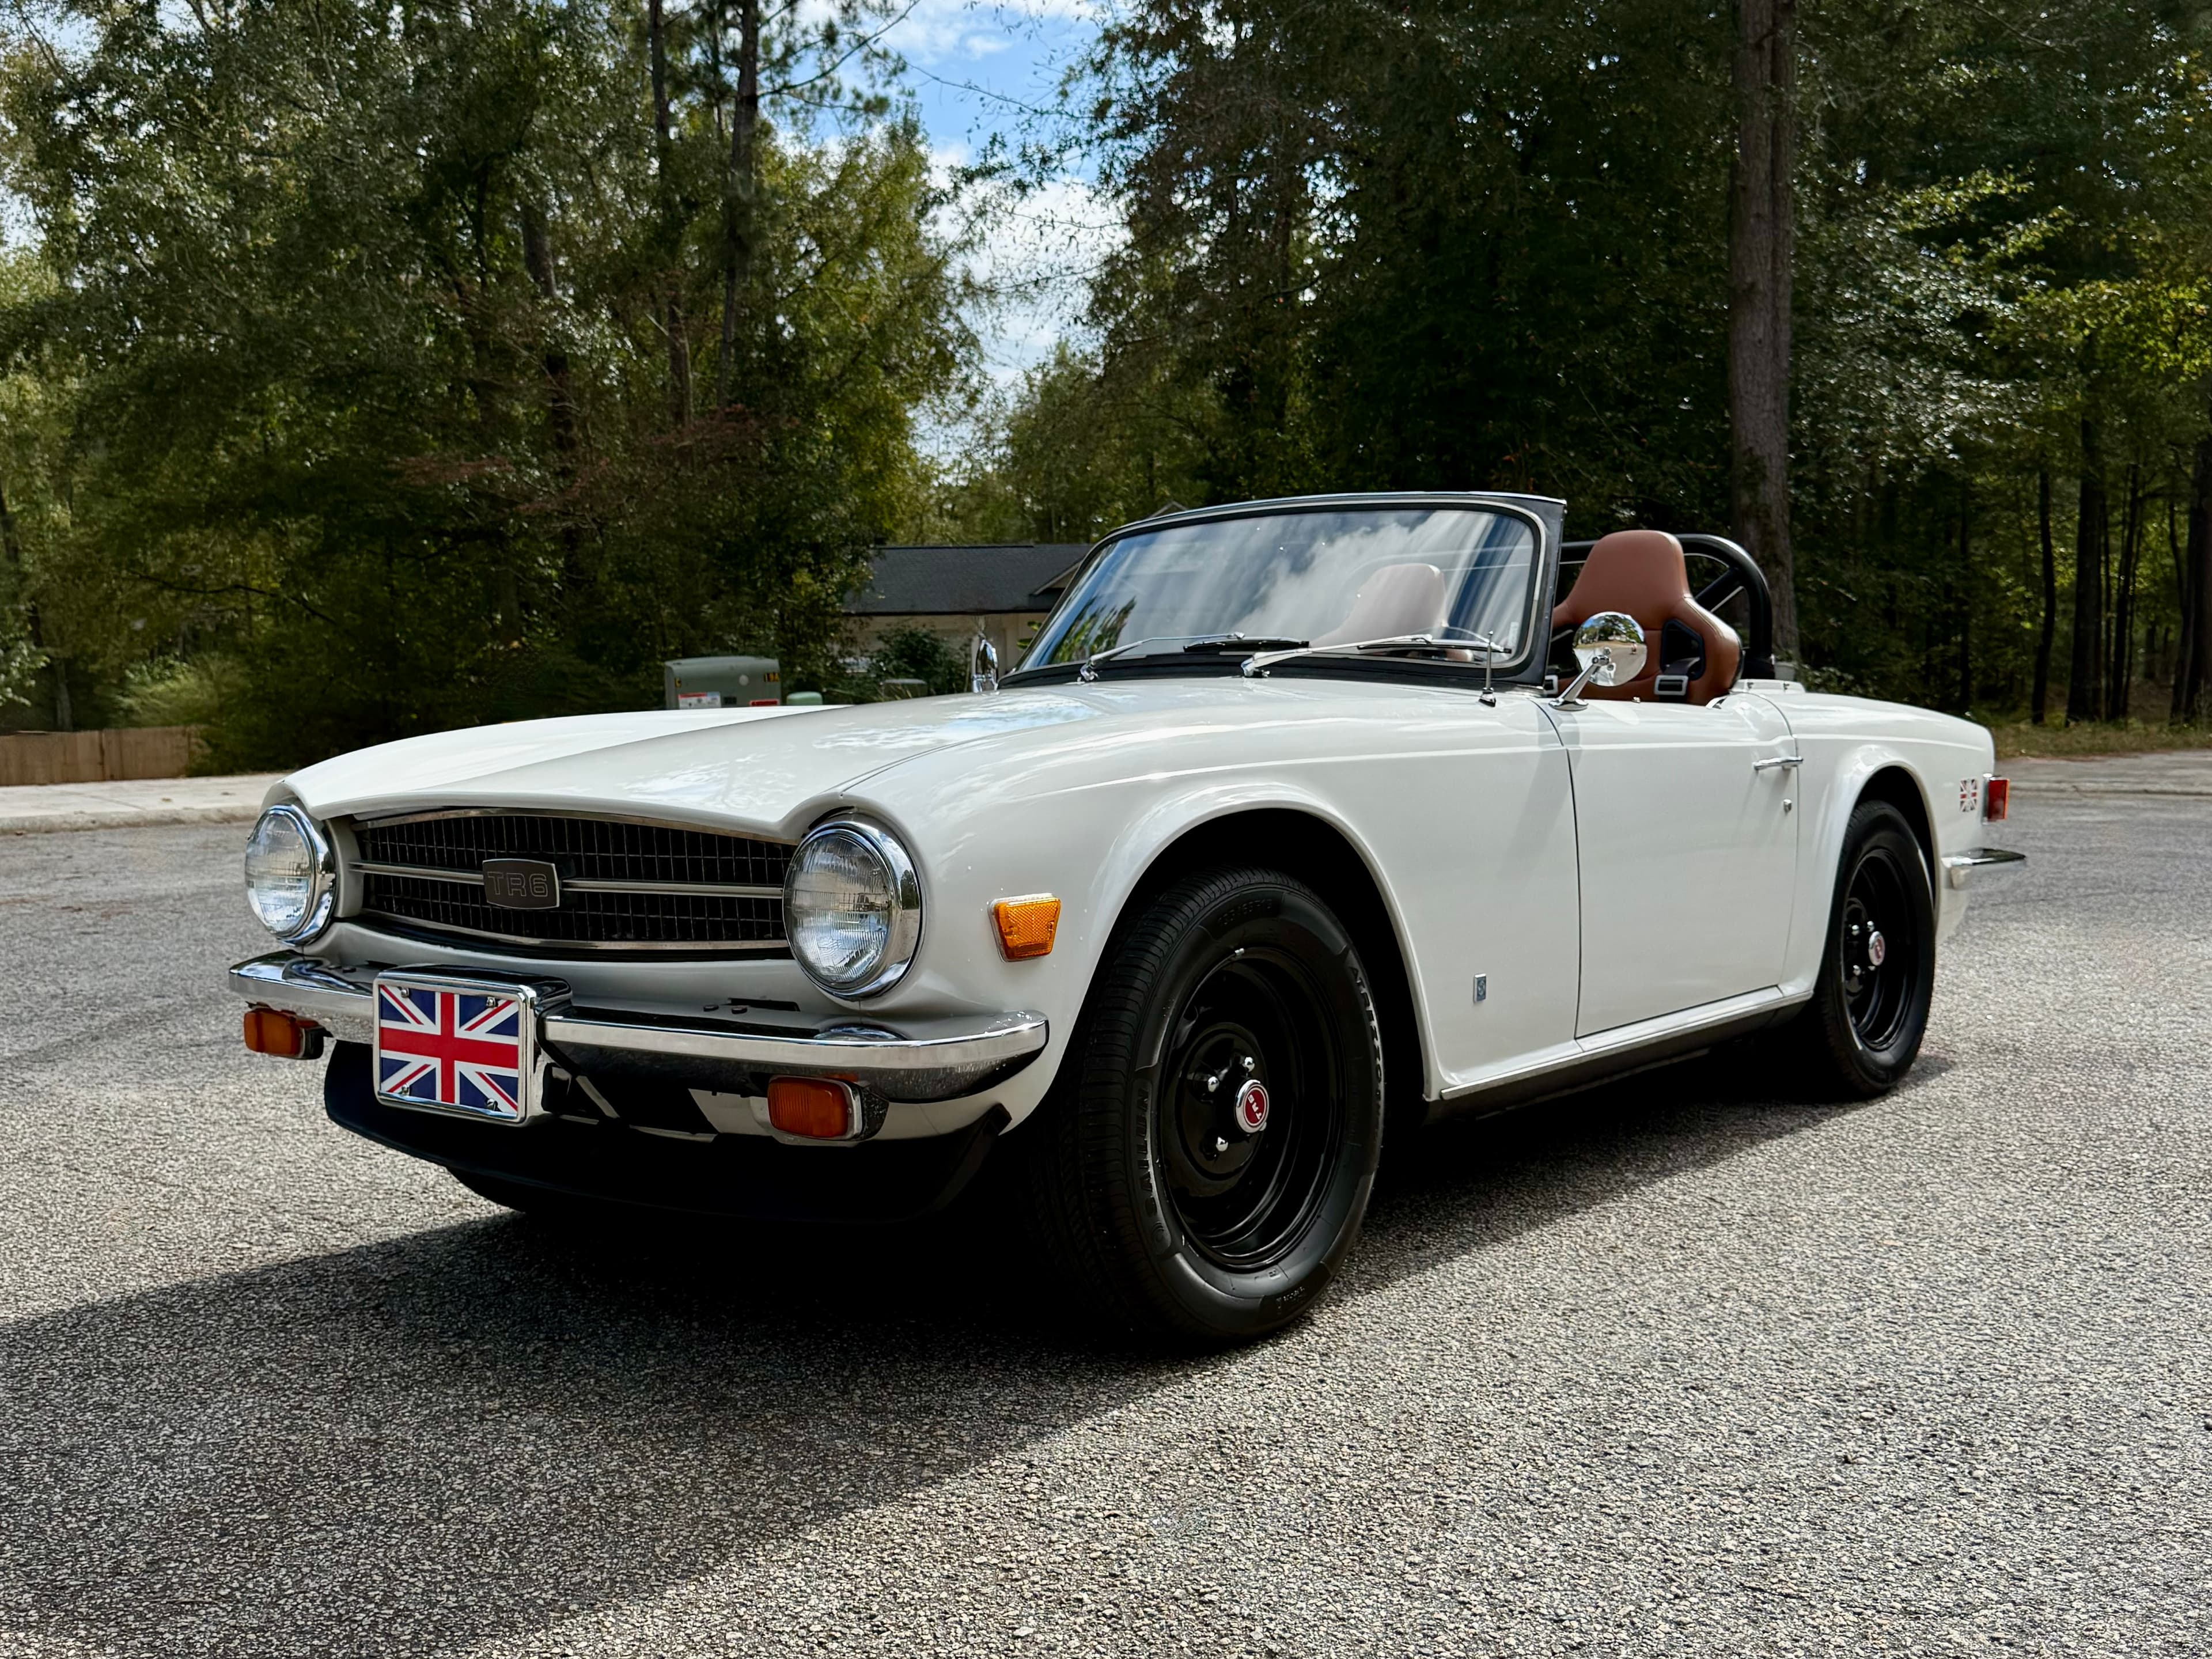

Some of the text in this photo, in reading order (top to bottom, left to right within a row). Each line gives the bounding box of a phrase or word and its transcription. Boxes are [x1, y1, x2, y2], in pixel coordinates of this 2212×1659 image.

[487, 871, 548, 897] TR6
[1348, 966, 1383, 1084] ATREZZO
[1136, 1088, 1158, 1217] SAILUN
